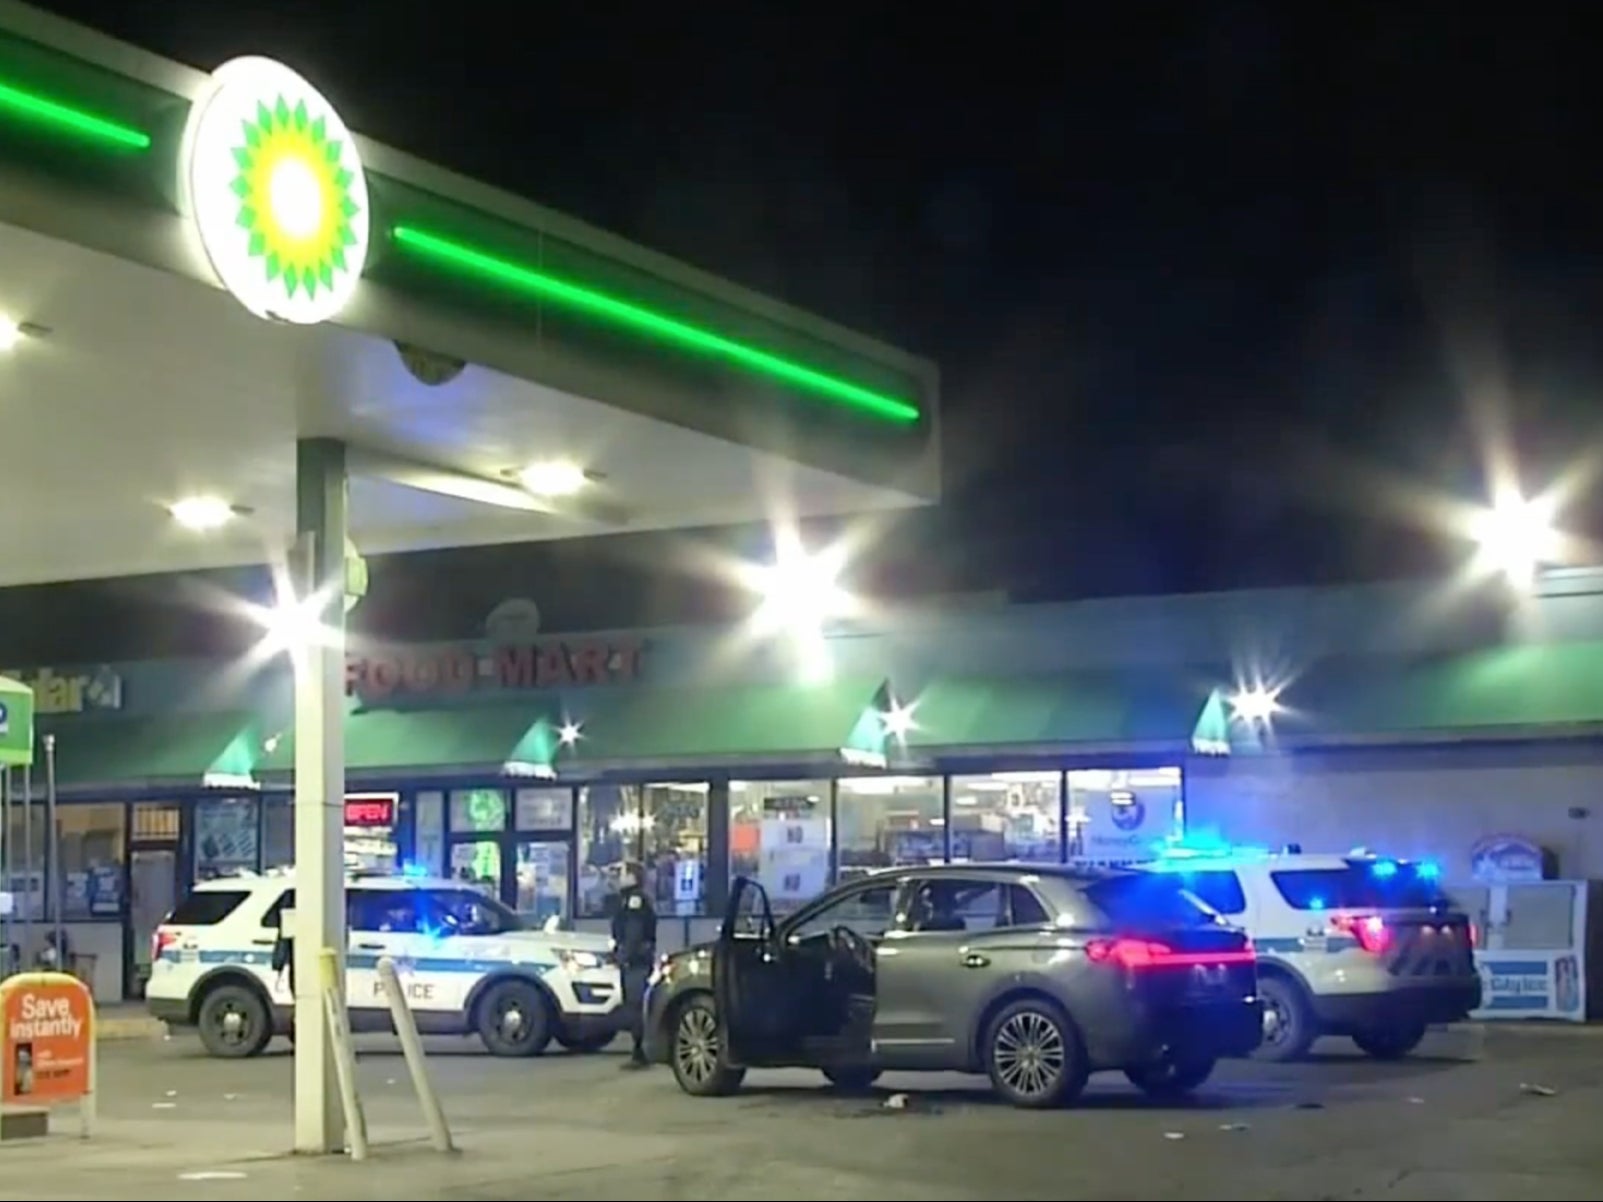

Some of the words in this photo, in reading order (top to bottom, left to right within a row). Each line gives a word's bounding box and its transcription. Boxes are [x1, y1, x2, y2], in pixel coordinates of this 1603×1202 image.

[496, 642, 645, 687] MART
[373, 981, 434, 1000] PICE
[22, 993, 70, 1020] Save
[10, 1014, 82, 1041] instantly
